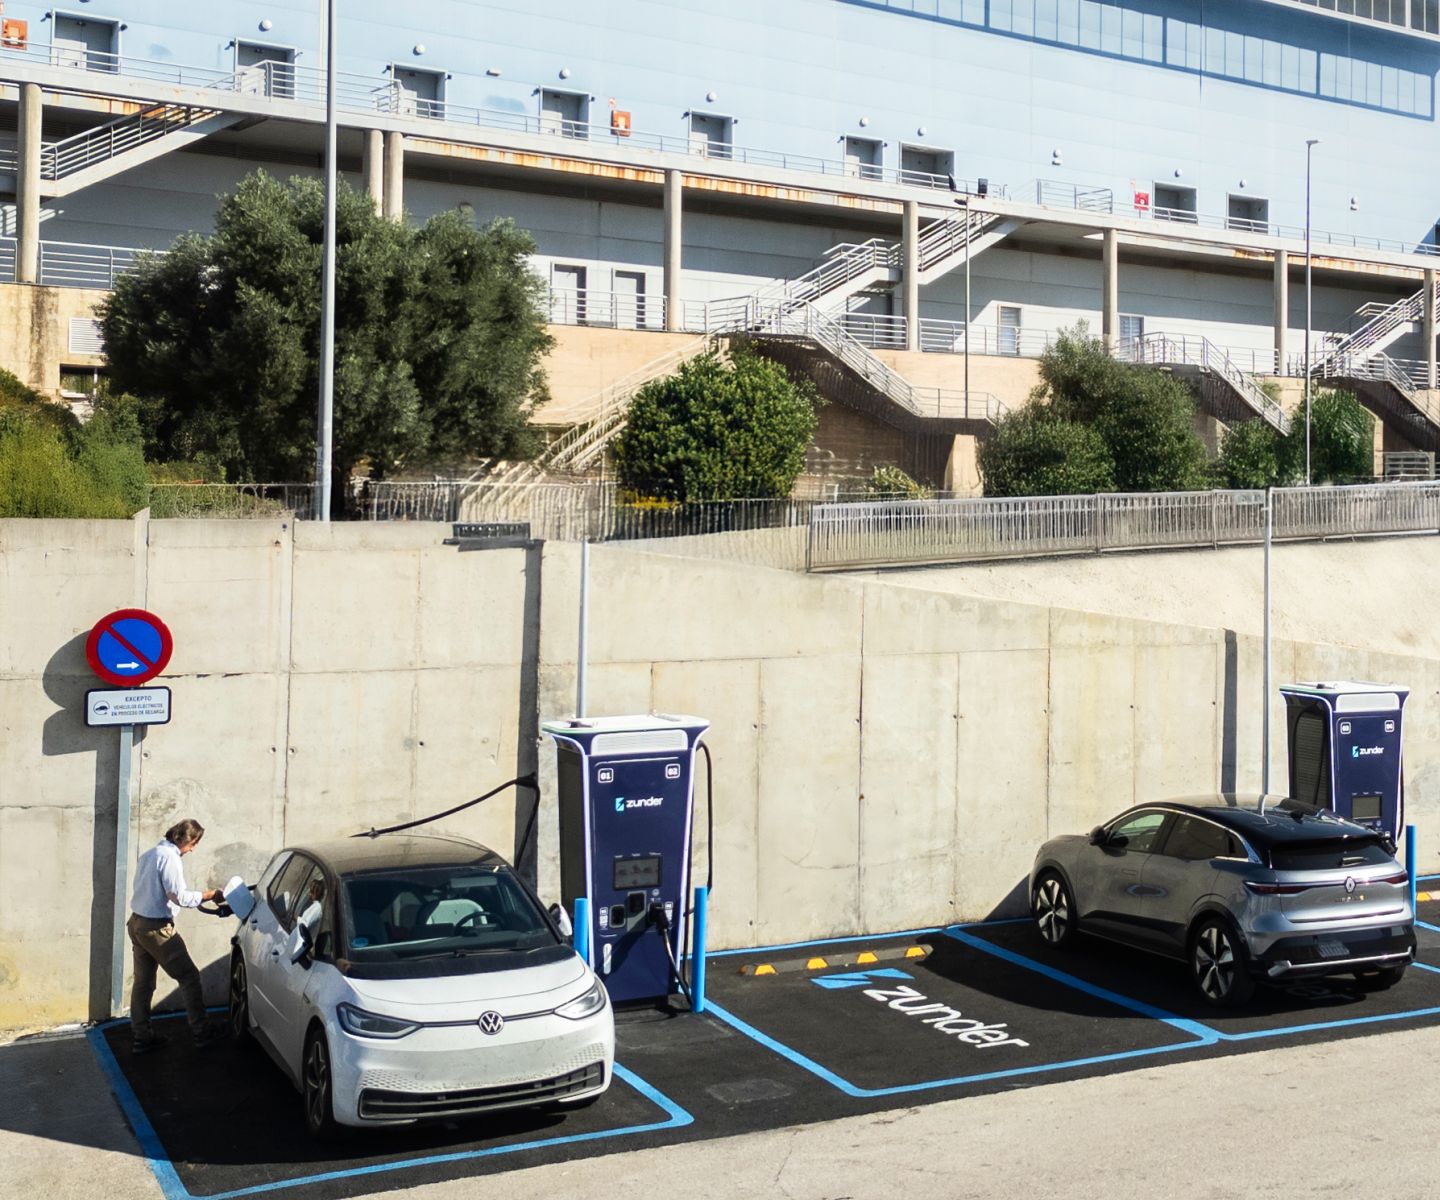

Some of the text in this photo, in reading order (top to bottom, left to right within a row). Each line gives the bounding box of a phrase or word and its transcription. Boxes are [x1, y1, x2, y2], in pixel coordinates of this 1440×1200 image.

[1360, 746, 1384, 754] zunder
[600, 772, 612, 780] 01
[626, 796, 664, 808] zunder
[863, 985, 1030, 1049] zunder
